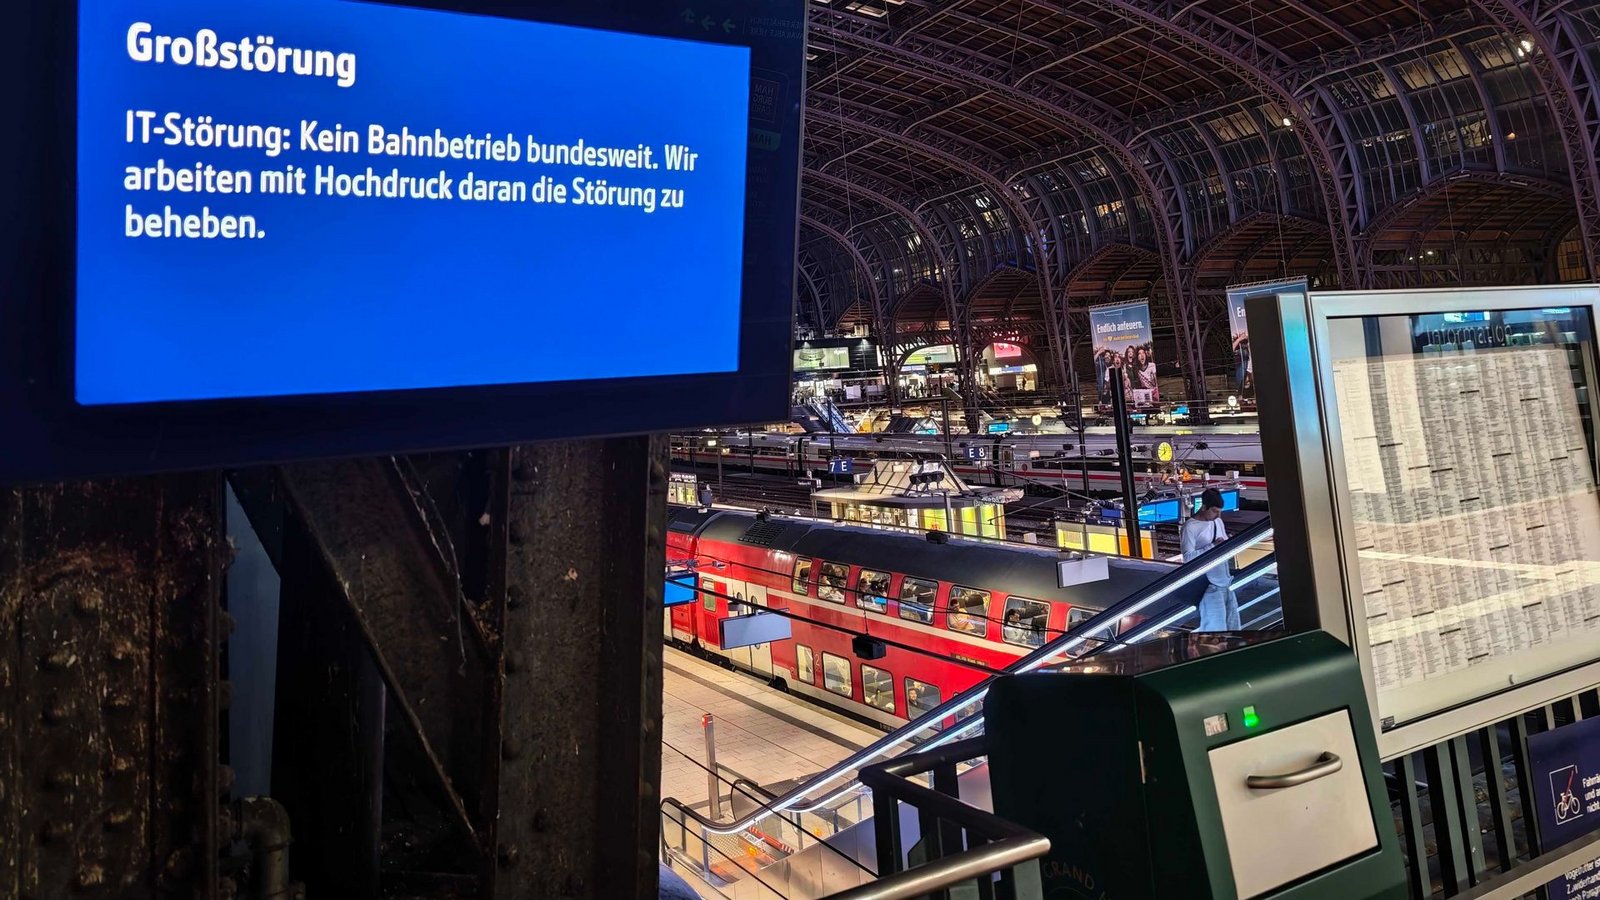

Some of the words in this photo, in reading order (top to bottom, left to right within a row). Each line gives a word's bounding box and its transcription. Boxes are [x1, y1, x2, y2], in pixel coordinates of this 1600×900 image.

[126, 21, 356, 88] Großstörung
[126, 109, 291, 157] IT-Störung:
[300, 119, 360, 154] Kein
[368, 124, 521, 163] Bahnbetrieb
[526, 134, 659, 170] bundesweit.
[664, 144, 699, 172] Wir
[123, 158, 252, 194] arbeiten
[260, 164, 307, 195] mit
[314, 164, 453, 200] Hochdruck
[458, 171, 527, 202] daran
[531, 175, 567, 204] die
[571, 177, 657, 213] Störung
[660, 188, 684, 209] zu
[125, 204, 266, 239] beheben.
[1096, 322, 1117, 334] Endlich
[1117, 320, 1144, 332] anfeuern.
[830, 461, 836, 472] 7
[841, 461, 848, 472] E
